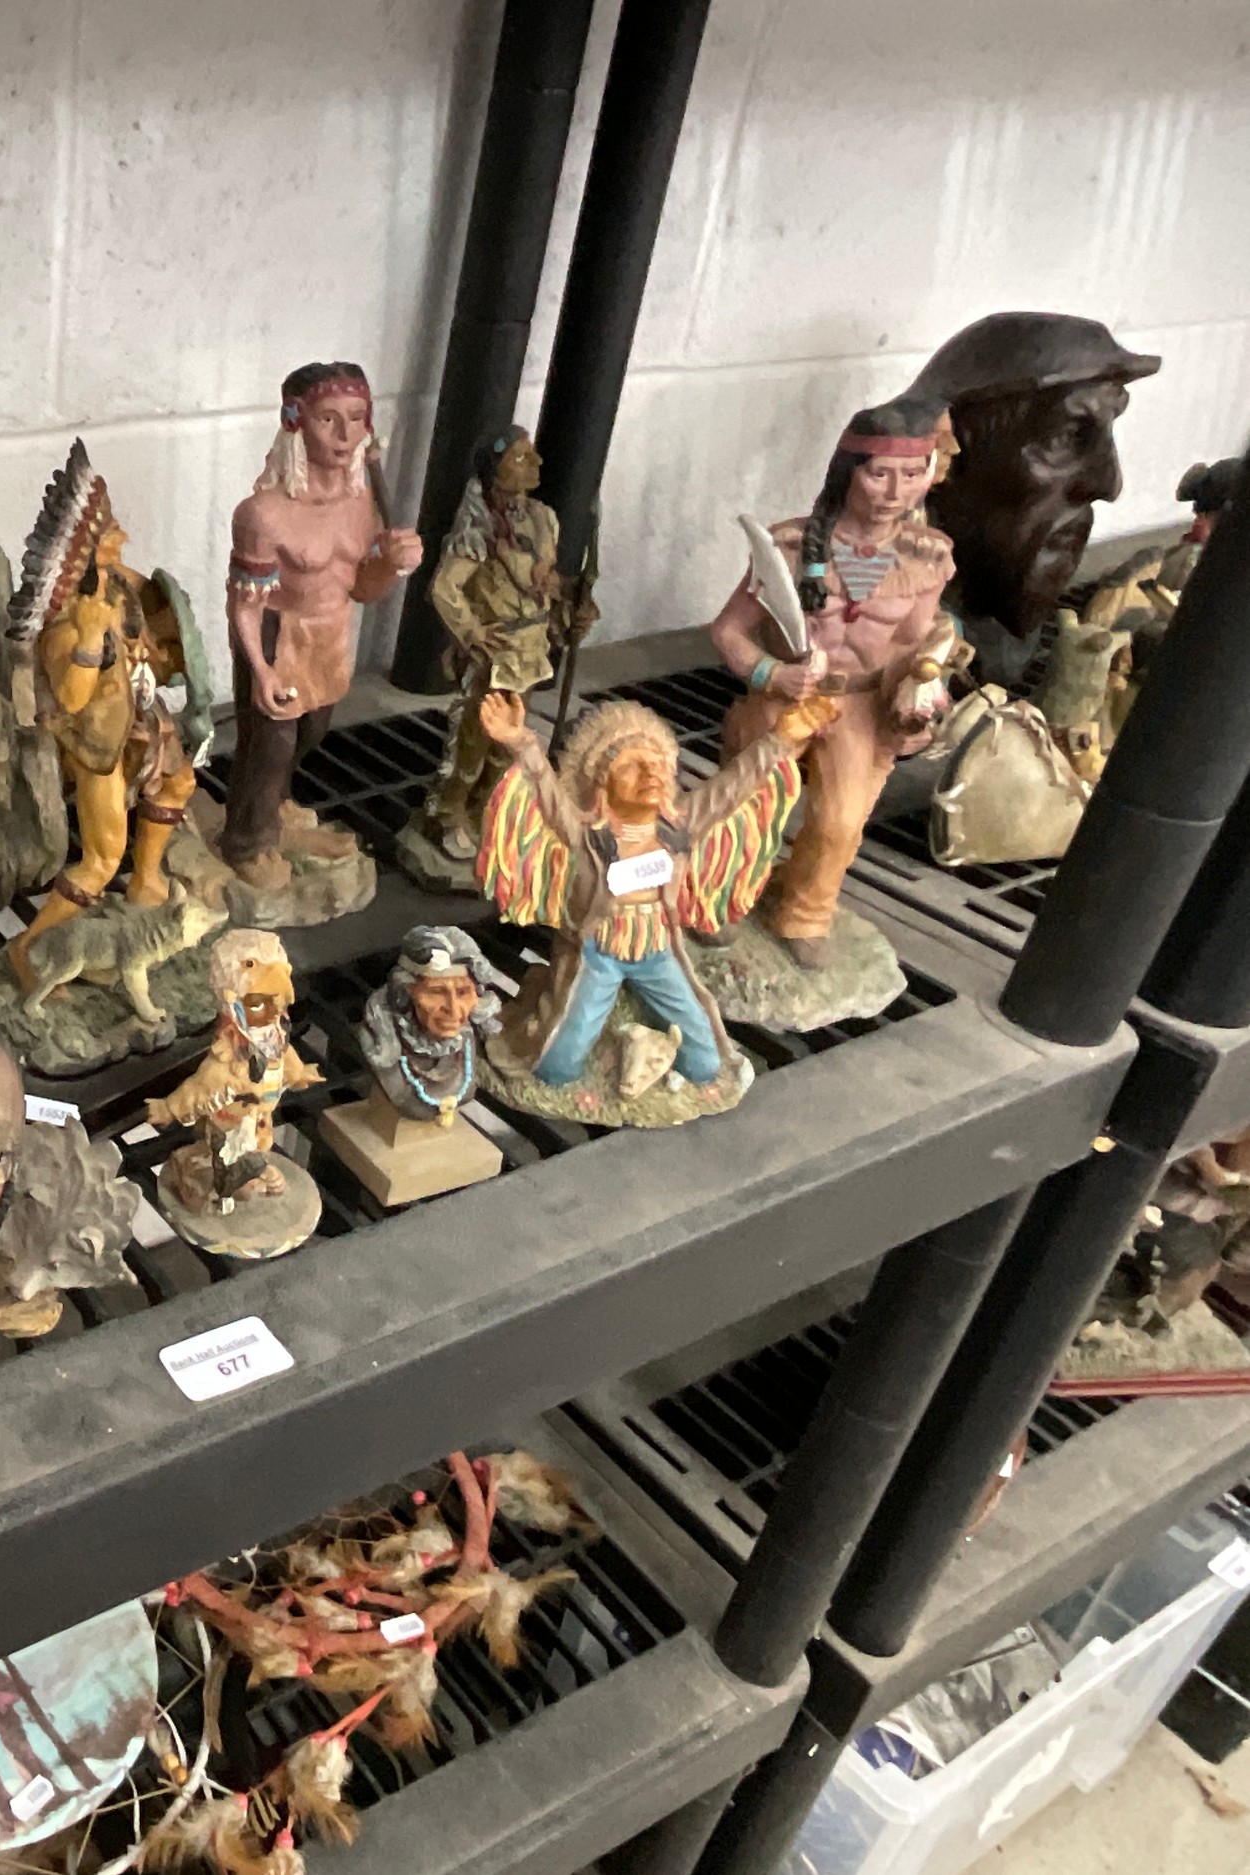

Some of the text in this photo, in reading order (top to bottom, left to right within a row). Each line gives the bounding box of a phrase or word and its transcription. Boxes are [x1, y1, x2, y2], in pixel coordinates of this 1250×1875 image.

[39, 1107, 71, 1120] 1553
[170, 1334, 259, 1372] Bank Hall Auctions
[217, 1354, 250, 1376] 677
